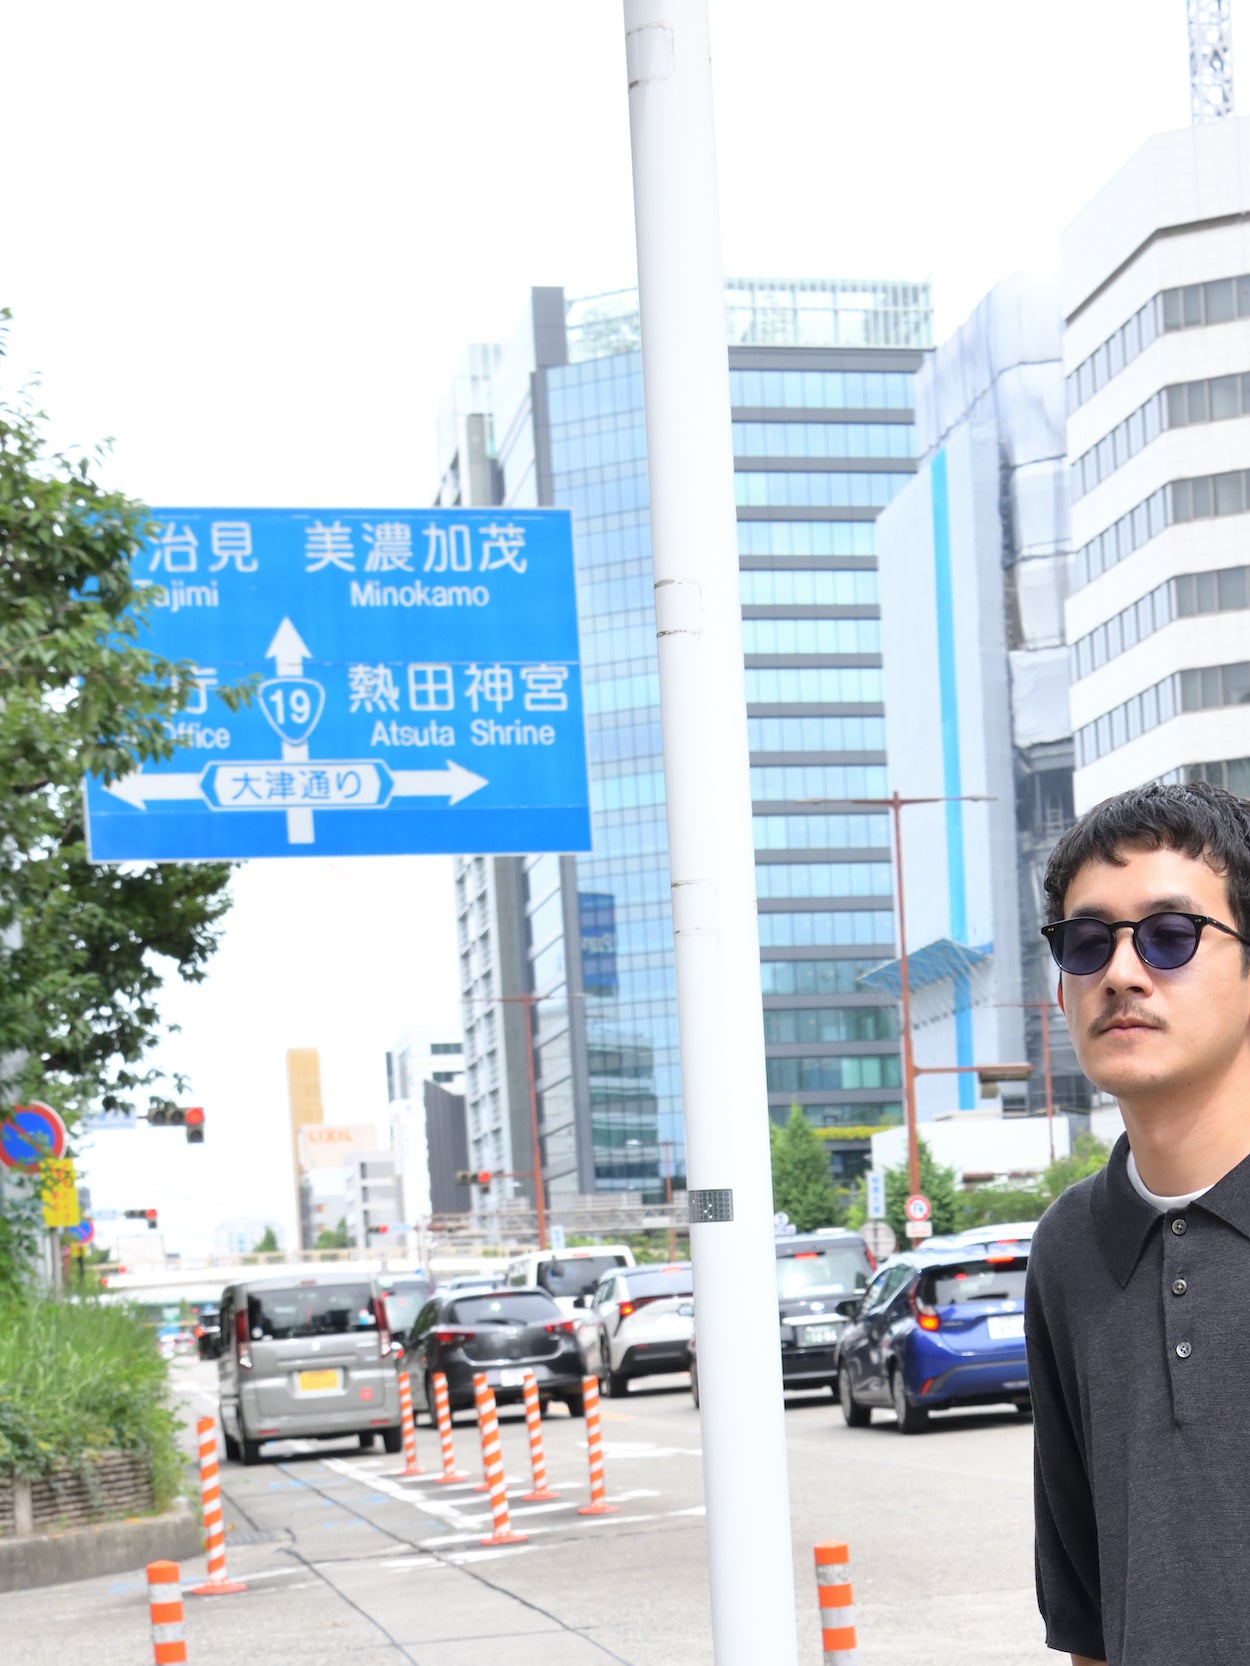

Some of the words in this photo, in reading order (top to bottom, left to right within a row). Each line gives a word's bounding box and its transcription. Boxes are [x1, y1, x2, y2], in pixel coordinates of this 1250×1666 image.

[129, 521, 259, 573] 治見
[304, 519, 528, 574] 美濃加茂
[350, 579, 490, 608] Minokamo
[347, 662, 568, 713] 熱田神宮
[269, 688, 311, 725] 19
[370, 719, 455, 747] Atsuta
[470, 718, 556, 746] Shrine
[231, 770, 361, 800] 大津通り
